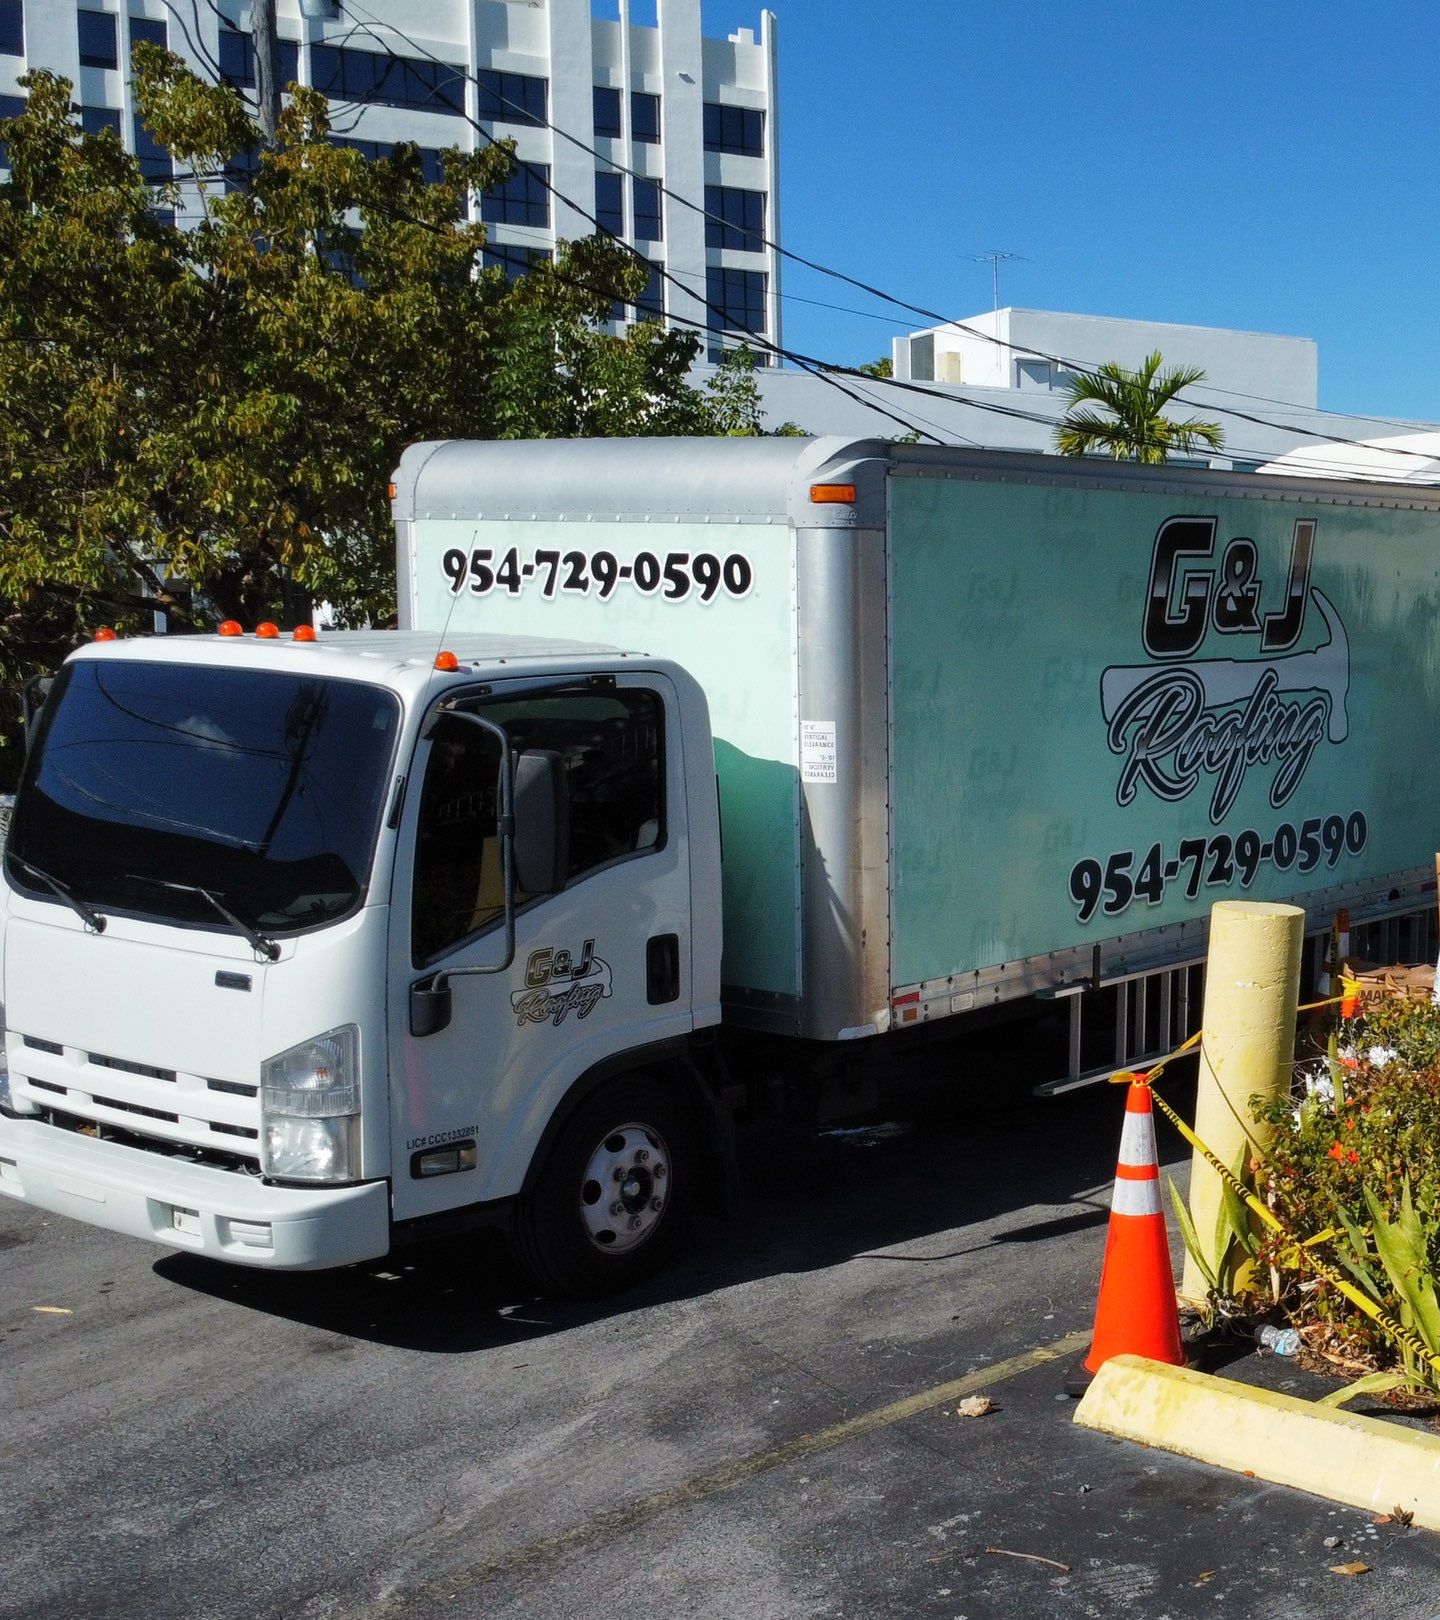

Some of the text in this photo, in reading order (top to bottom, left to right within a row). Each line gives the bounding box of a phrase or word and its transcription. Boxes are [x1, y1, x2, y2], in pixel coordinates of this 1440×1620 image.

[441, 545, 754, 606] 954-729-0590
[1142, 515, 1318, 658] G&J
[1108, 668, 1327, 825] Roofing
[1069, 811, 1367, 923] 954-729-0590
[513, 982, 604, 1026] Roofing
[524, 939, 595, 989] G&J
